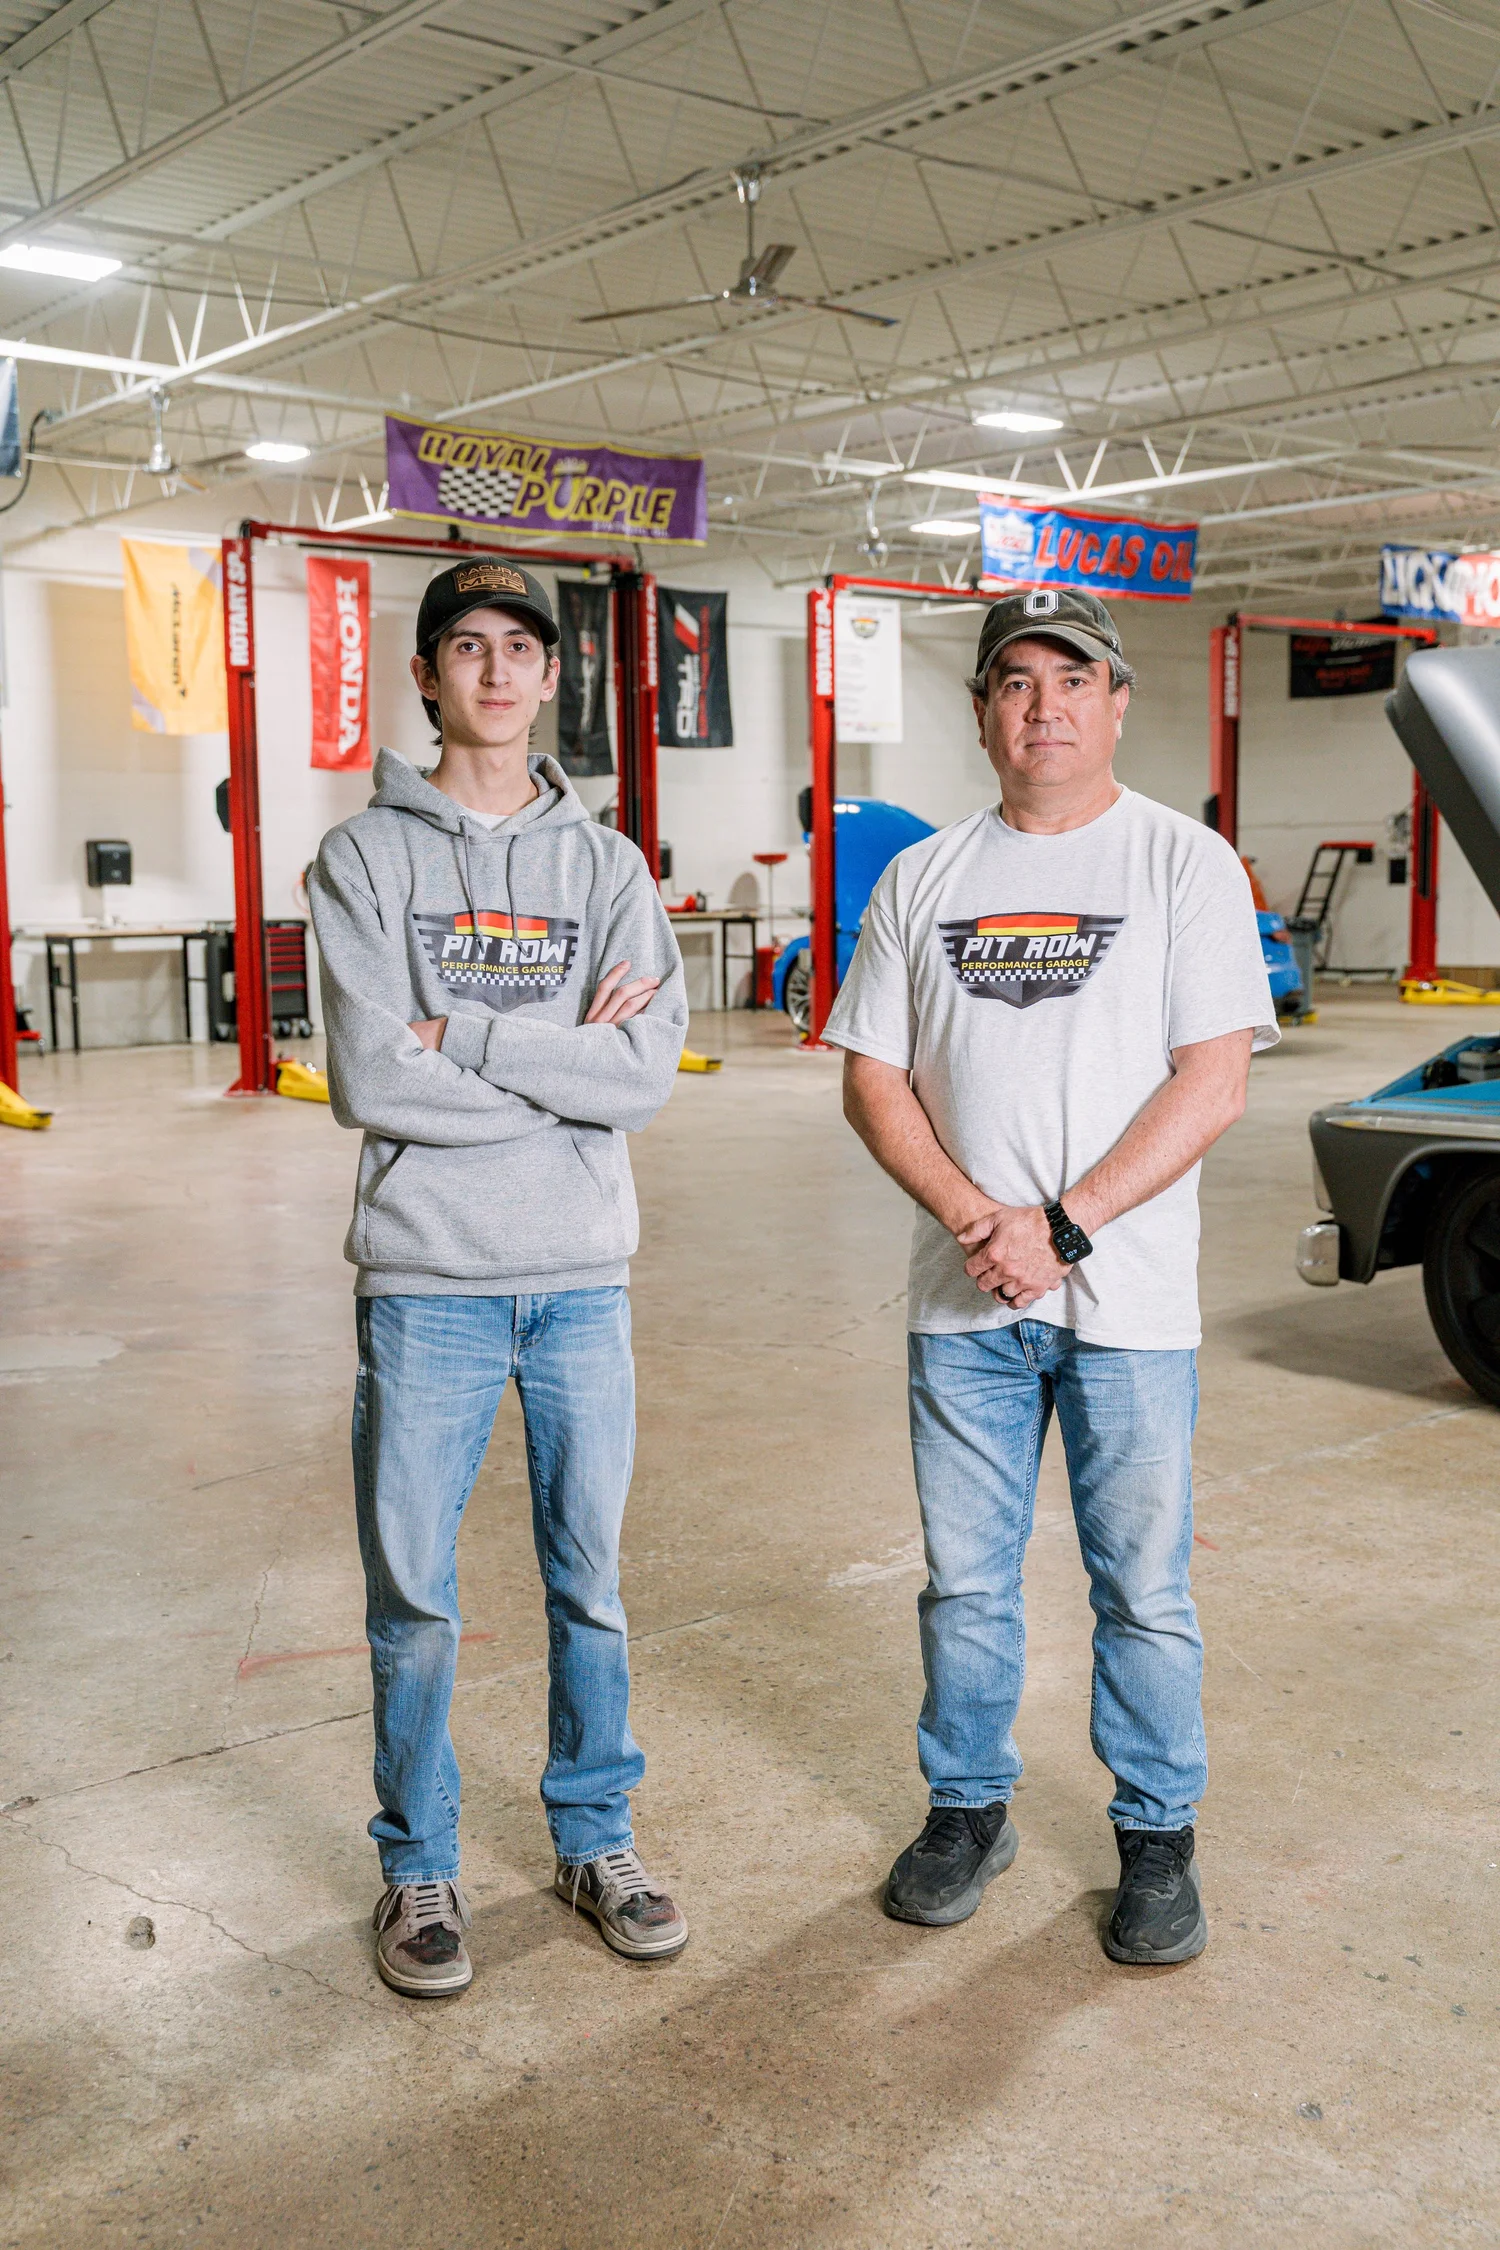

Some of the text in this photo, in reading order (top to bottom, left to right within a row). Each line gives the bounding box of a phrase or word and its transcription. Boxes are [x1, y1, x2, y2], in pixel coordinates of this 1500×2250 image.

[419, 430, 550, 475] ROYAL
[513, 474, 676, 528] PURPLE
[469, 565, 523, 580] ACURA
[1034, 526, 1145, 579] LUCAS
[1151, 540, 1194, 583] OIL
[1023, 588, 1059, 618] O
[228, 583, 250, 667] ROTARY
[336, 576, 362, 755] HONDA
[647, 614, 658, 687] ROTARY
[441, 934, 568, 964] PIT ROW
[961, 933, 1097, 960] PIT ROW
[961, 959, 1090, 970] PERFORMANCE GARAGE
[442, 961, 565, 974] PERFORMANCE GARAGE
